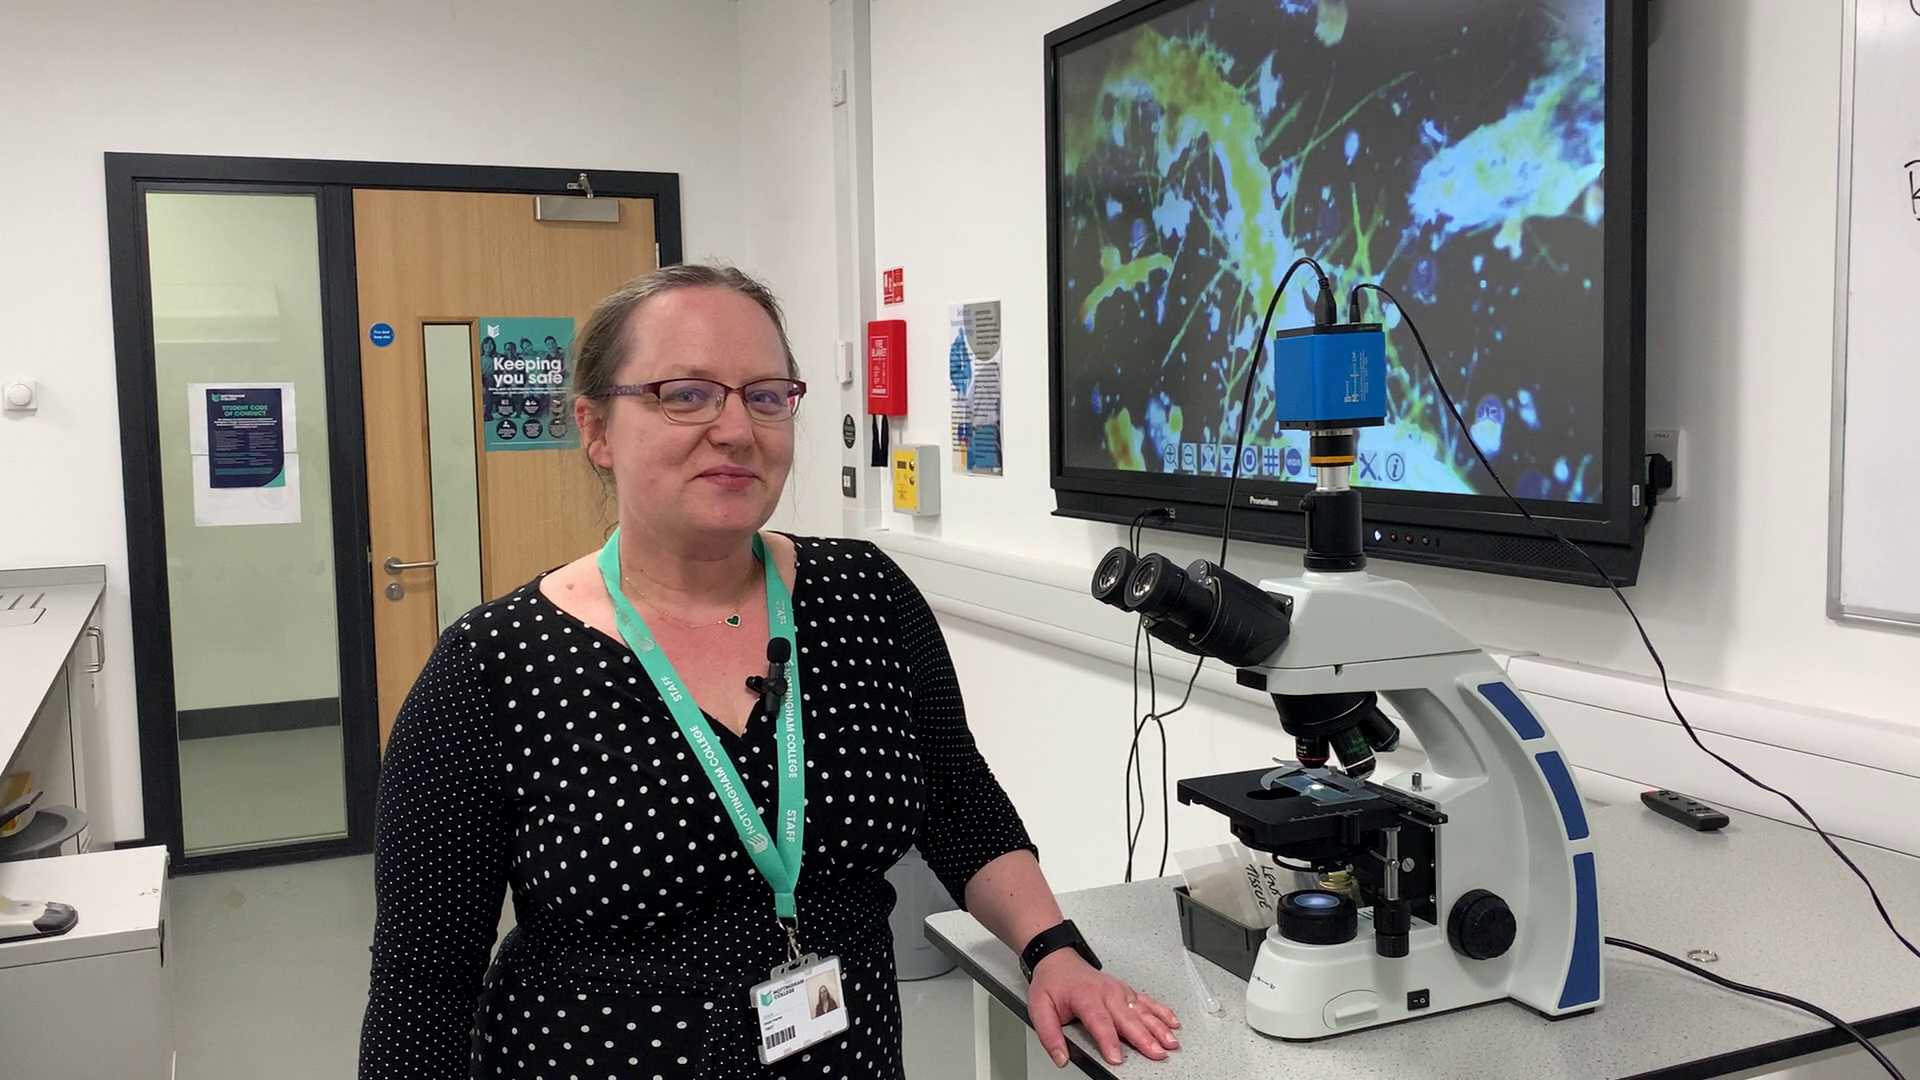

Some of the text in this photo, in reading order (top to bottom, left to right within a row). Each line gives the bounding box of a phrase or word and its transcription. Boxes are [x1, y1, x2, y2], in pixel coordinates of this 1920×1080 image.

[493, 357, 562, 373] Keeping
[493, 371, 563, 388] you safe
[660, 675, 683, 702] STAFF
[786, 733, 798, 779] COLLEGE
[689, 724, 757, 836] NOTTINGHAM COLLEGE
[785, 809, 797, 843] STAFF
[773, 979, 804, 994] NOTTINGHAM
[773, 988, 795, 1000] COLLEGE
